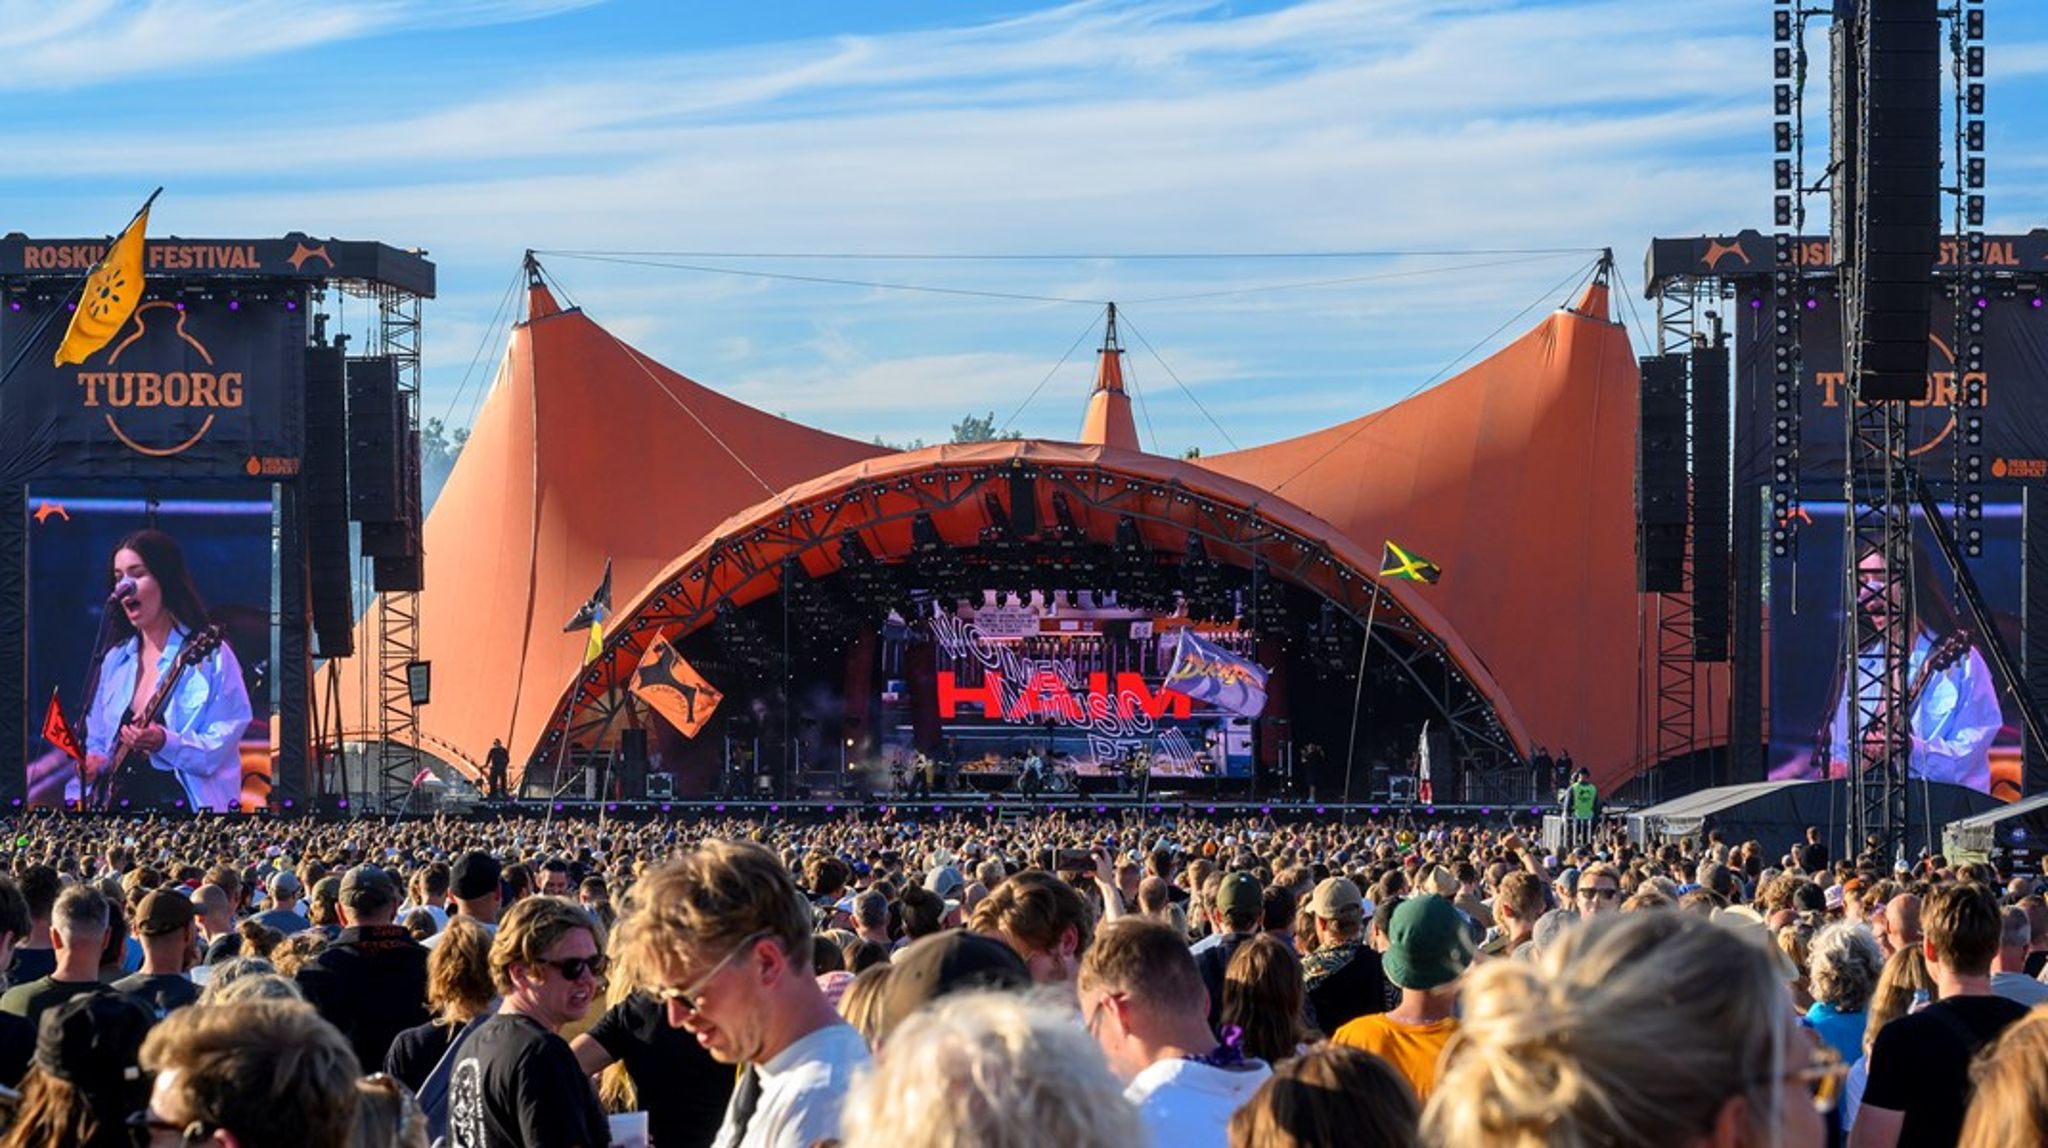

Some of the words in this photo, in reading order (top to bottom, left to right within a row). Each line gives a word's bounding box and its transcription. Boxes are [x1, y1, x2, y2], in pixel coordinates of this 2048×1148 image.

[24, 245, 105, 269] ROSKI
[150, 245, 261, 269] FESTIVAL
[77, 372, 243, 408] TUBORG
[1816, 371, 1988, 408] TRG
[937, 670, 1191, 720] HAIM
[1037, 690, 1154, 738] MUSIC
